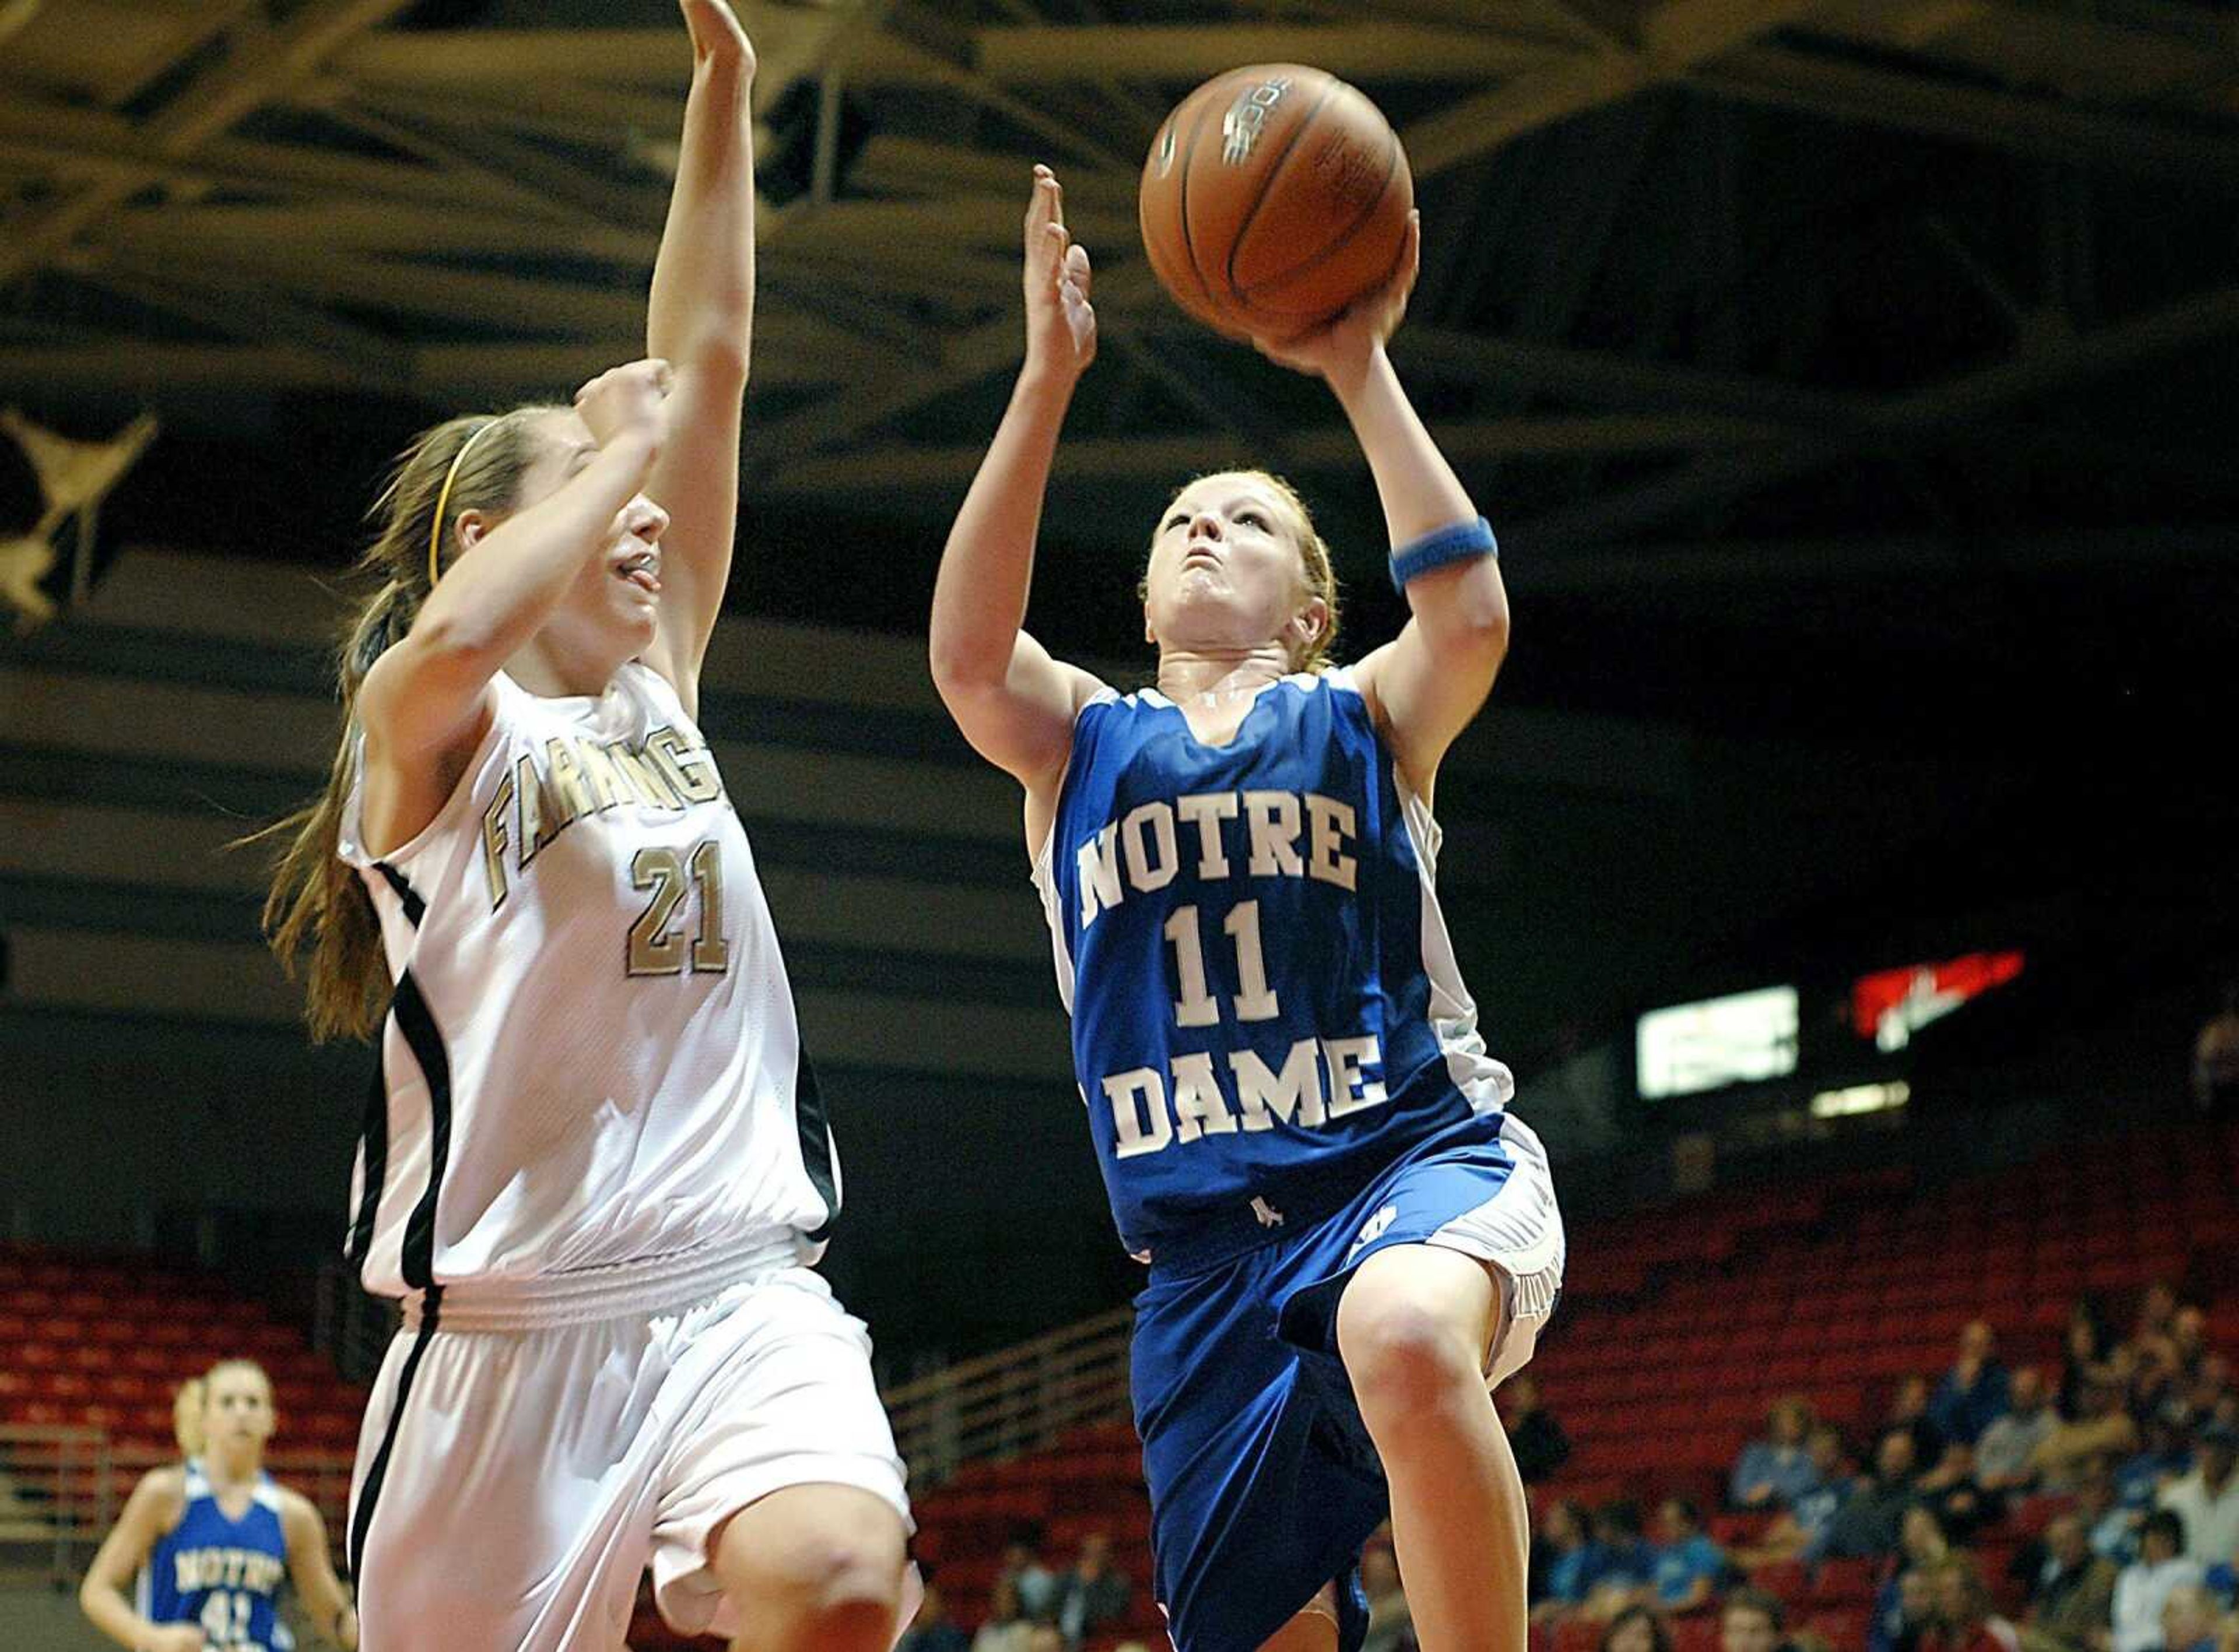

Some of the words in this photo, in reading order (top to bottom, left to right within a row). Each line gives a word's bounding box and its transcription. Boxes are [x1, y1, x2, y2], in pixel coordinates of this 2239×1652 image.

[627, 840, 728, 978] 21
[1077, 789, 1357, 930] NOTRE
[1164, 899, 1280, 1028] 11
[1101, 1034, 1388, 1159] DAME
